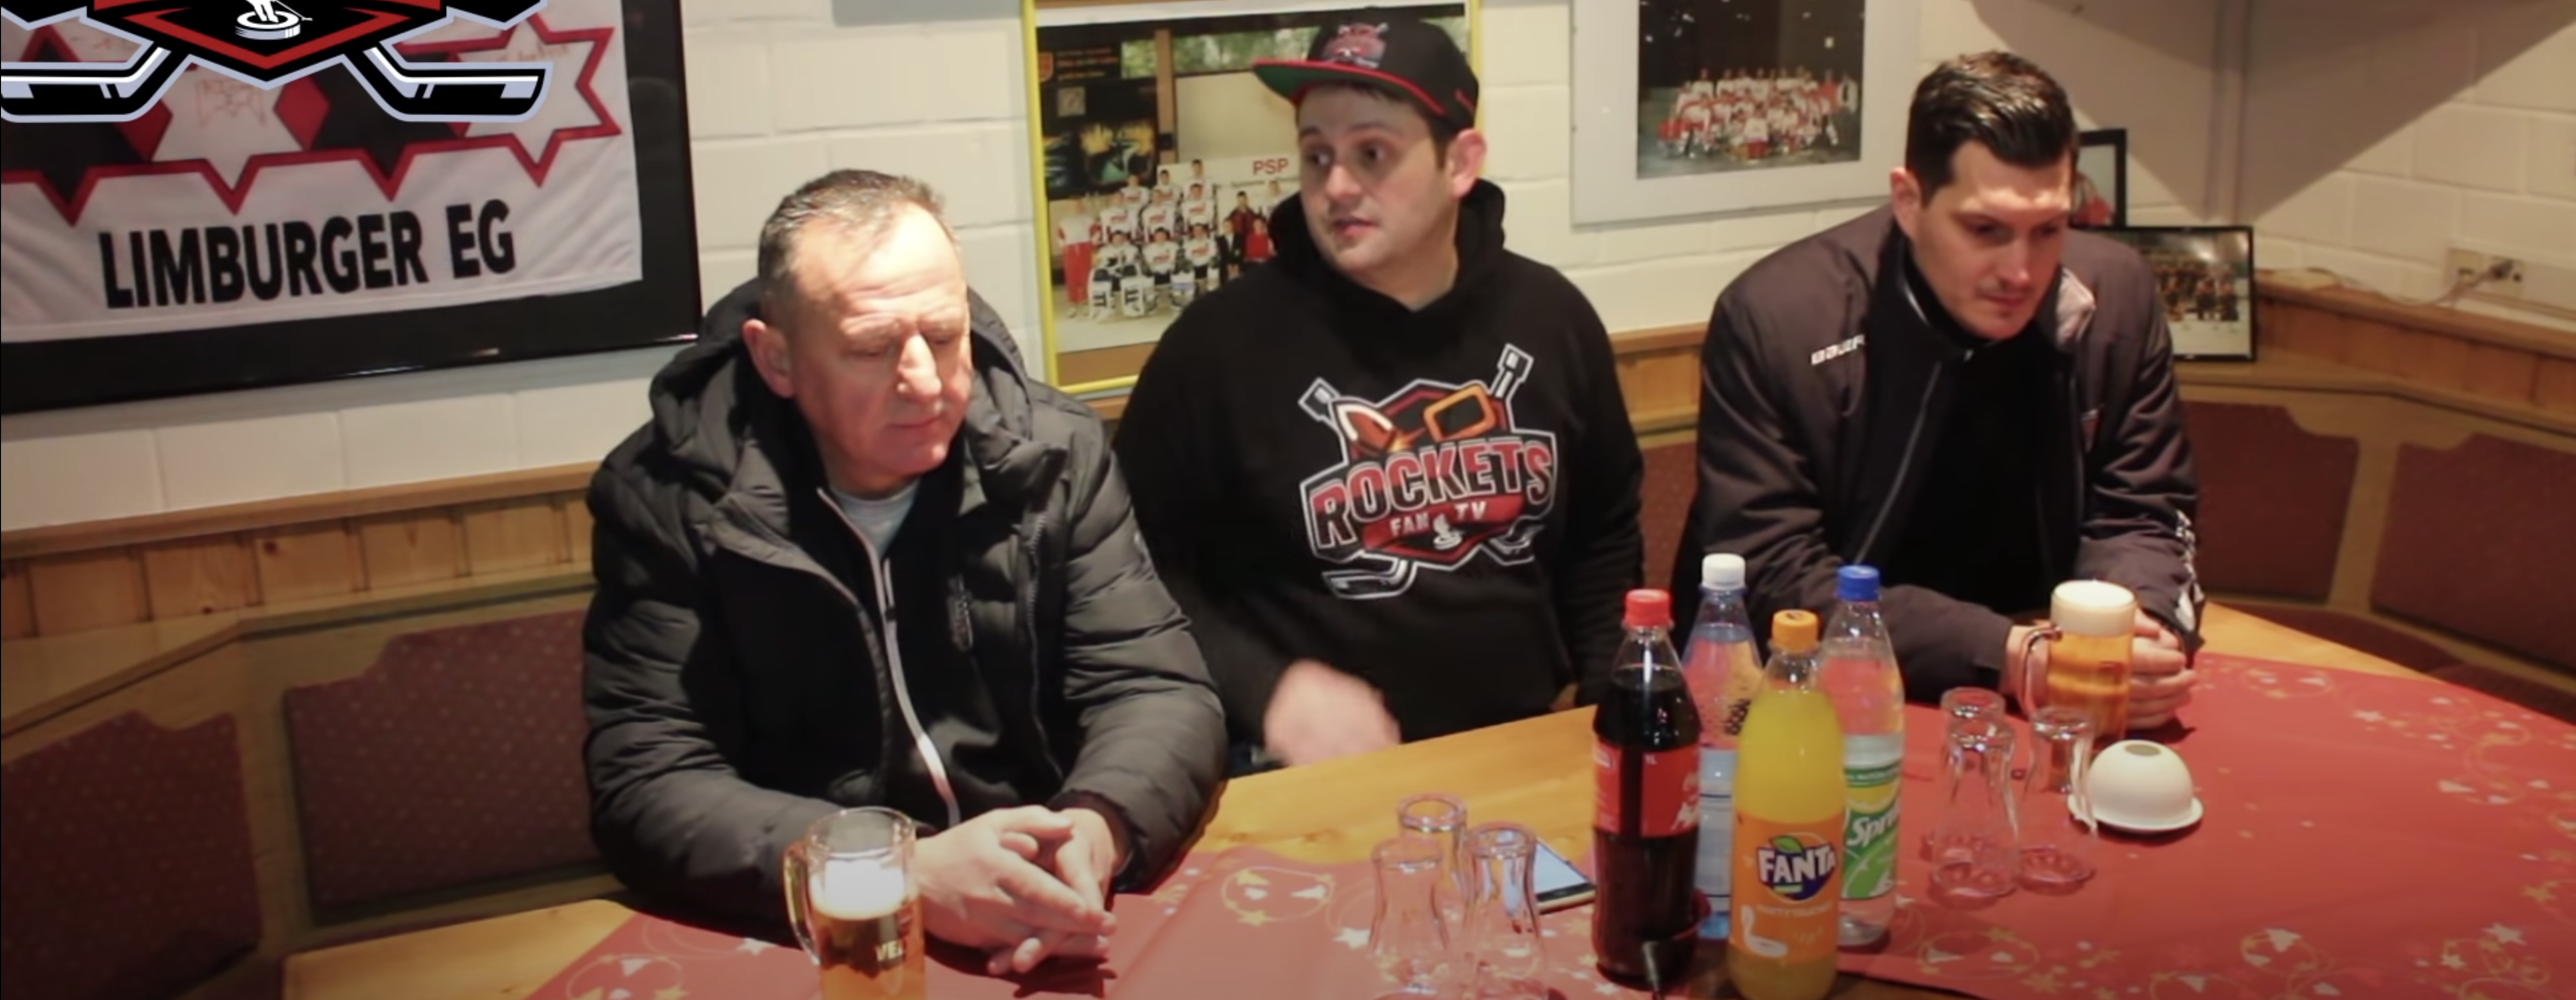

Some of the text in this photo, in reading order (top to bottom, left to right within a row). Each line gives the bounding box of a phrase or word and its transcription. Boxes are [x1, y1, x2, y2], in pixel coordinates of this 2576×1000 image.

[1253, 157, 1289, 176] PSP
[98, 198, 516, 309] LIMBURGER EG
[1308, 439, 1553, 550] ROCKETS
[1390, 501, 1487, 537] FAN TV
[1757, 844, 1836, 883] FANTA
